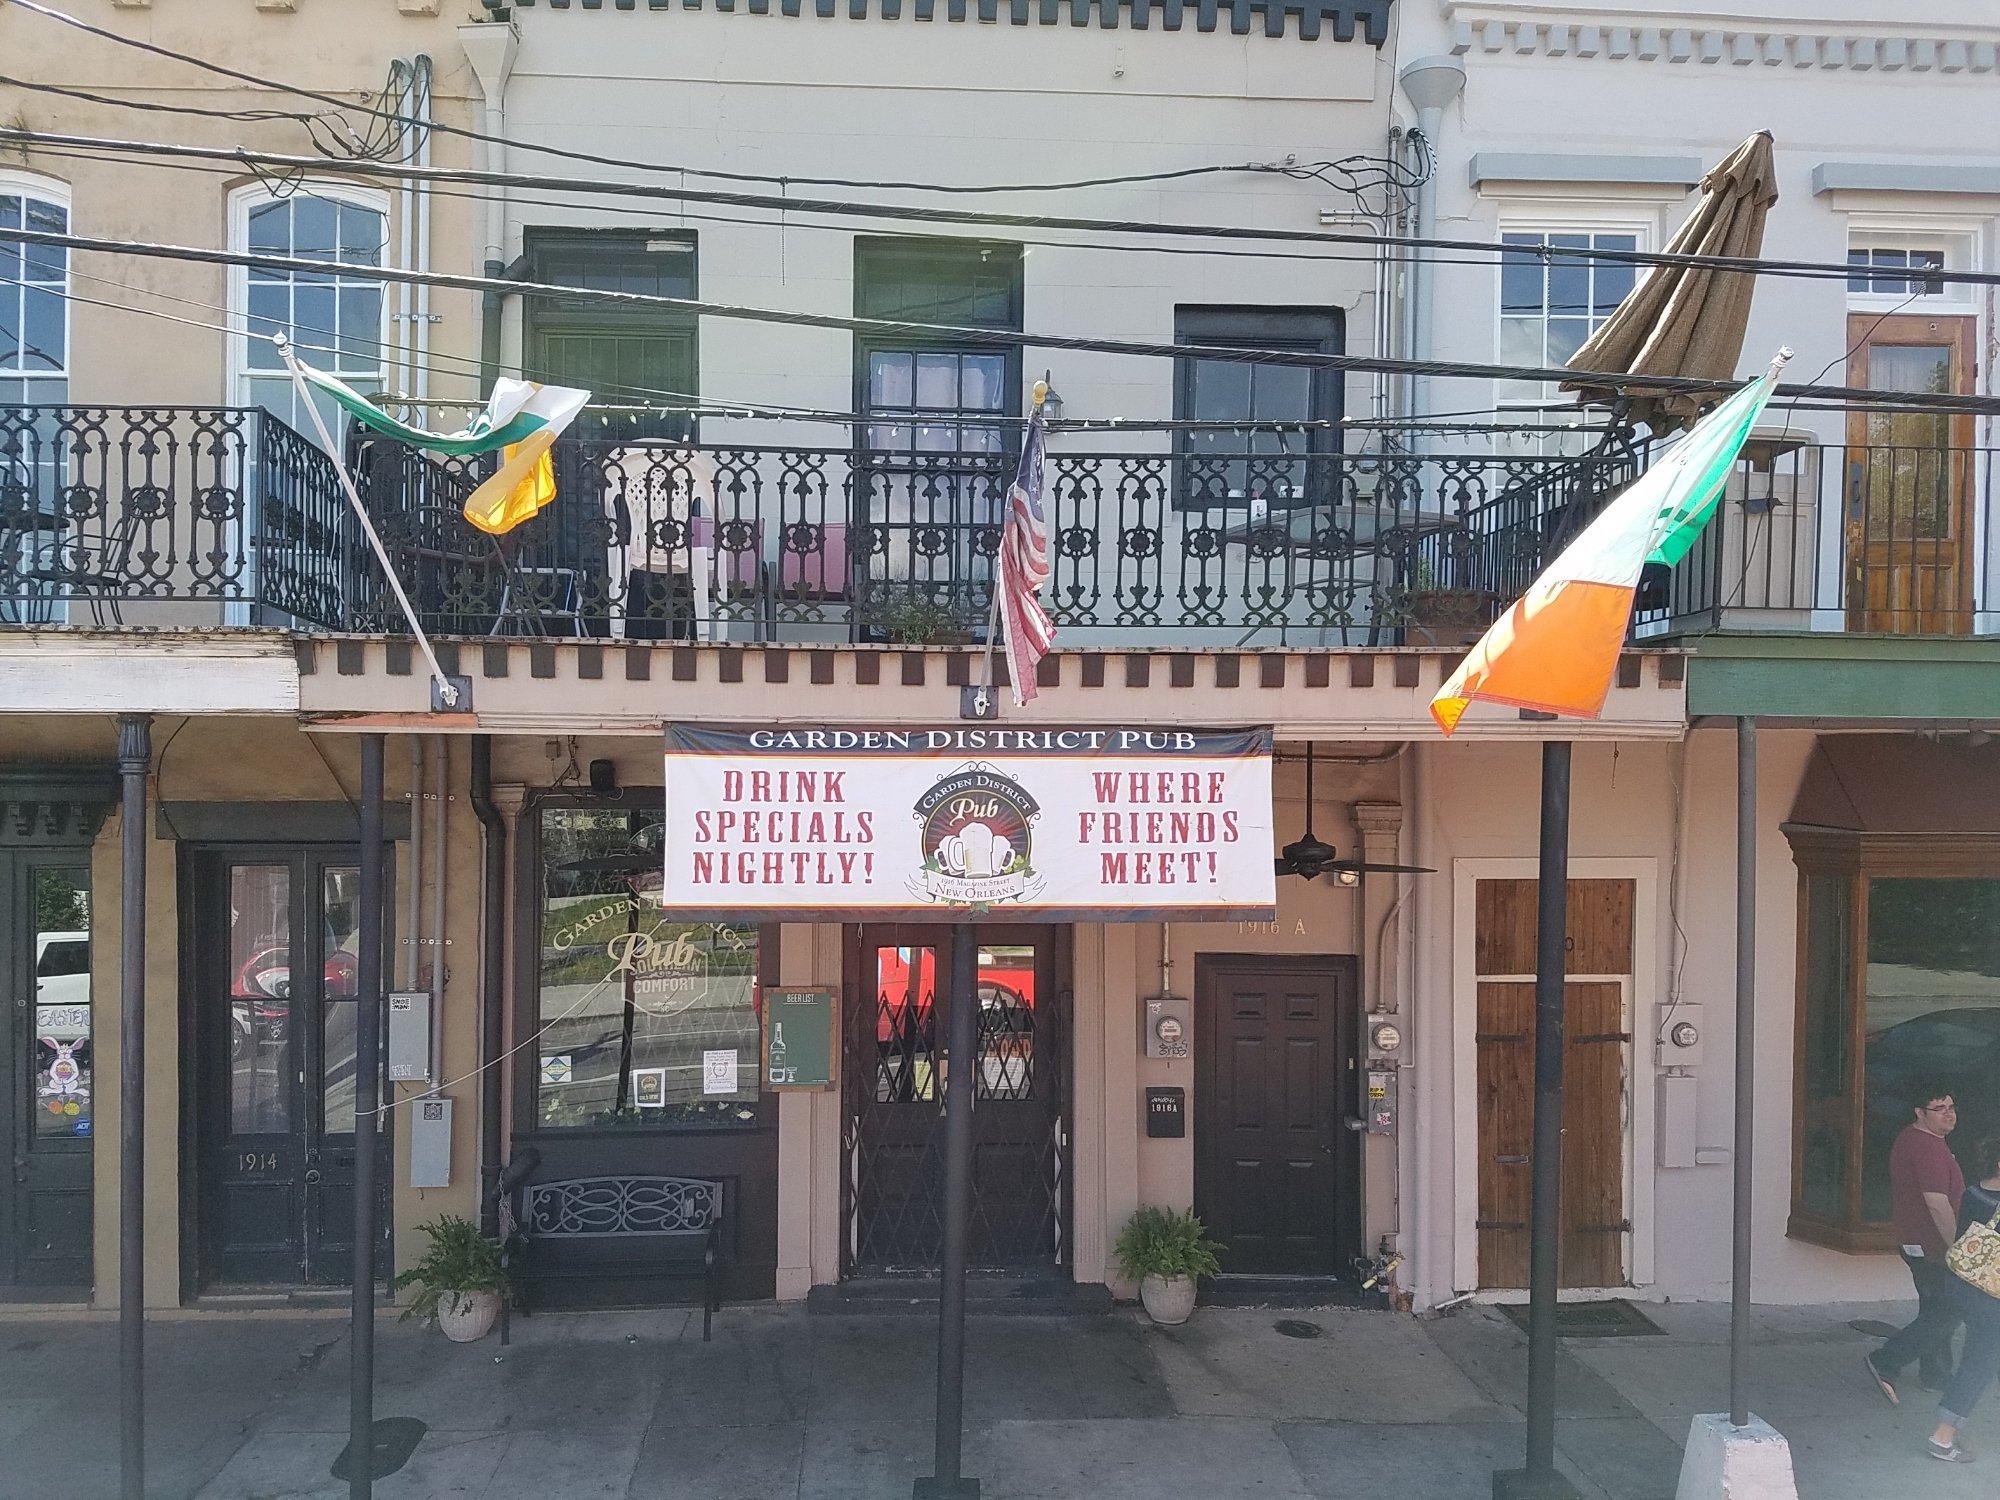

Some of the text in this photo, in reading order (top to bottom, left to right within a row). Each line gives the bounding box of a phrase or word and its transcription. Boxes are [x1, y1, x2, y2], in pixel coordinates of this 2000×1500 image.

[749, 730, 1196, 750] GARDEN DISTRICT PUB
[722, 770, 847, 803] DRINK
[923, 775, 1032, 811] GARDEN DISTRICT
[1091, 772, 1226, 804] WHERE
[694, 810, 874, 843] SPECIALS
[949, 797, 1000, 827] Pub
[1078, 810, 1239, 844] FRIENDS
[692, 851, 875, 884] NIGHTLY!
[1100, 851, 1218, 885] MEET!
[934, 882, 1015, 898] NEW ORLEANS
[553, 898, 641, 951] GARDEN
[1294, 918, 1305, 934] A
[606, 931, 696, 982] Pub
[632, 976, 696, 994] COMFORT
[786, 993, 815, 1003] BEER LIST
[239, 1153, 277, 1171] 1914
